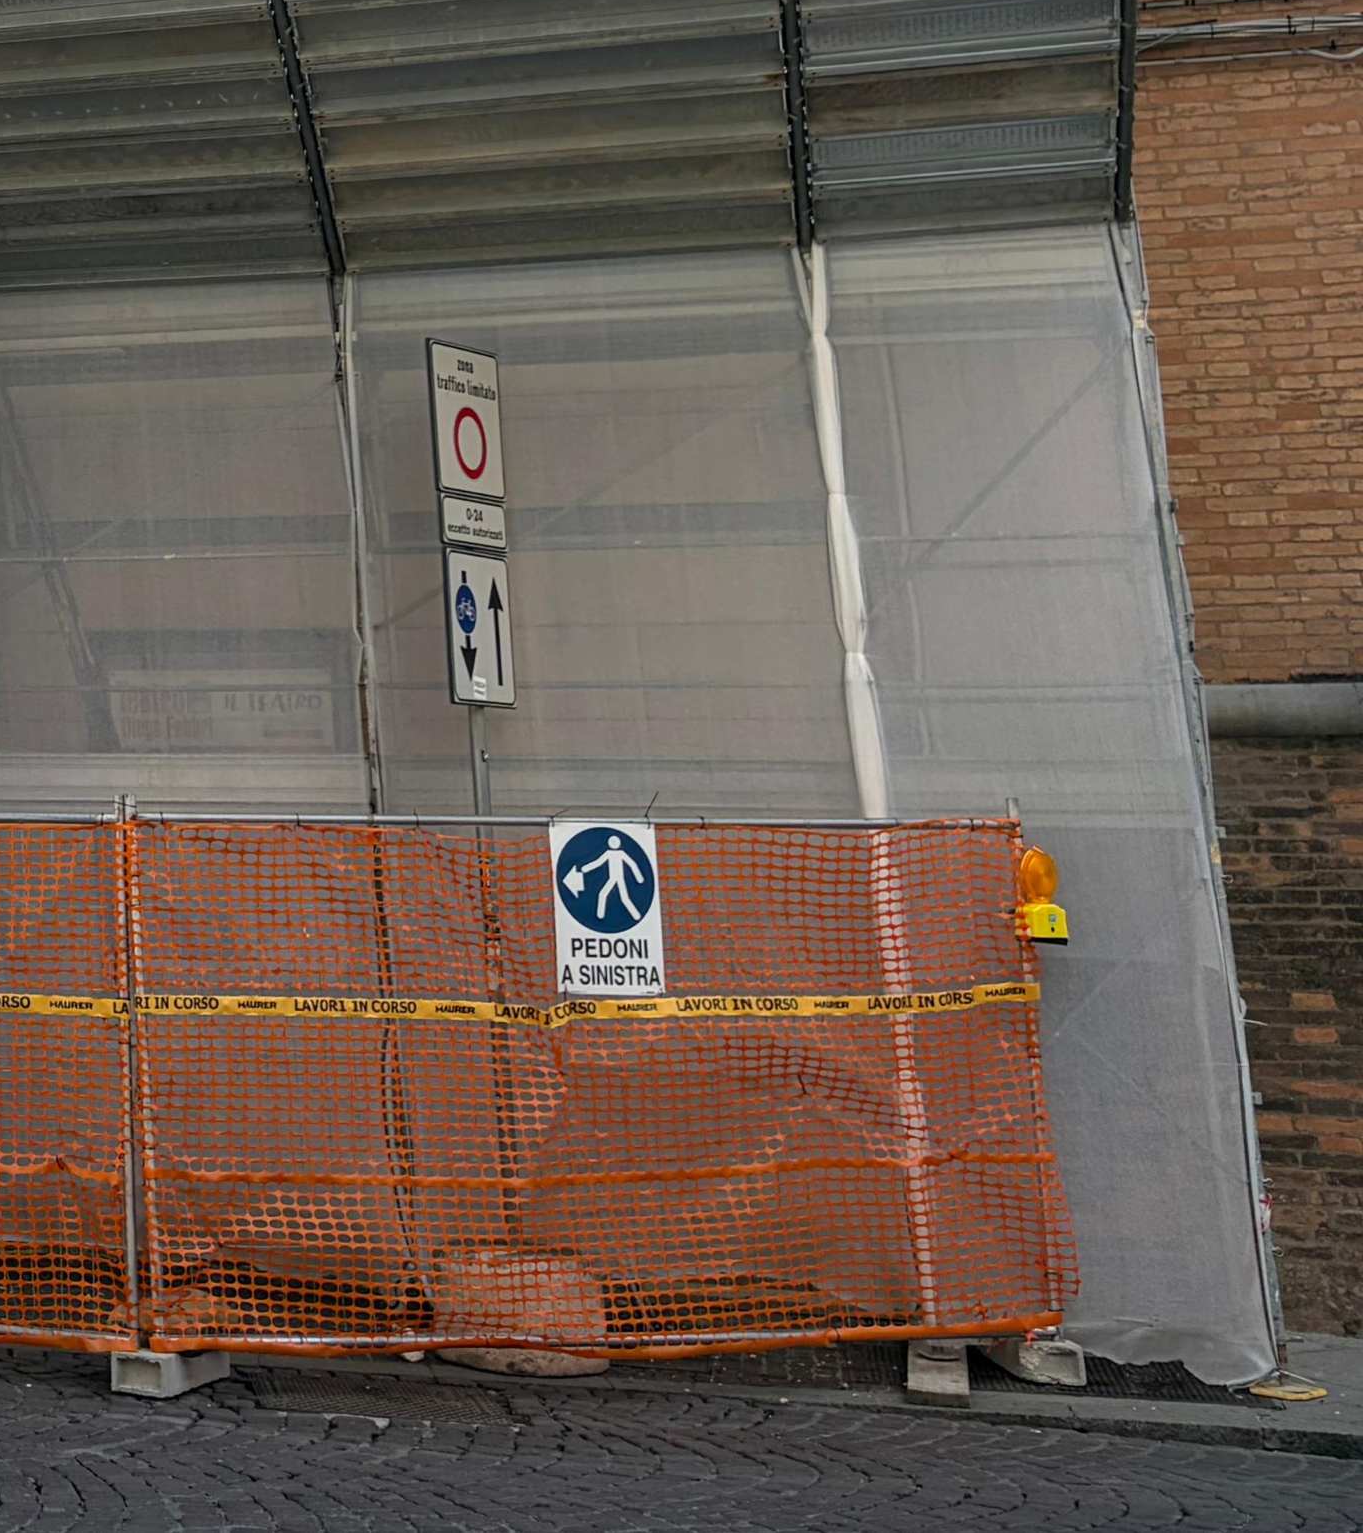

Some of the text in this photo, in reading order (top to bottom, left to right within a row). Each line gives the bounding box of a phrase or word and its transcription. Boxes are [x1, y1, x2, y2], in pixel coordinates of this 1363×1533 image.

[457, 359, 474, 374] zona
[437, 373, 496, 401] traffico limitato
[571, 938, 649, 959] PEDONI
[561, 964, 662, 986] A SINISTRA
[985, 987, 1025, 997] MAURER
[49, 1000, 93, 1010] MAURER
[155, 997, 169, 1009] IN
[174, 997, 219, 1009] CORSO
[238, 1001, 277, 1009] MAURER
[294, 999, 416, 1013] LAVORI IN CORSO
[617, 1003, 657, 1011] MAURER
[676, 998, 798, 1012] LAVORI IN CORSO
[814, 1001, 849, 1009] MAURER
[868, 995, 913, 1009] LAVORI
[918, 996, 935, 1008] IN
[435, 1006, 475, 1014] MAURER
[495, 1005, 539, 1020] LAVORI
[556, 1002, 596, 1018] CORSO
